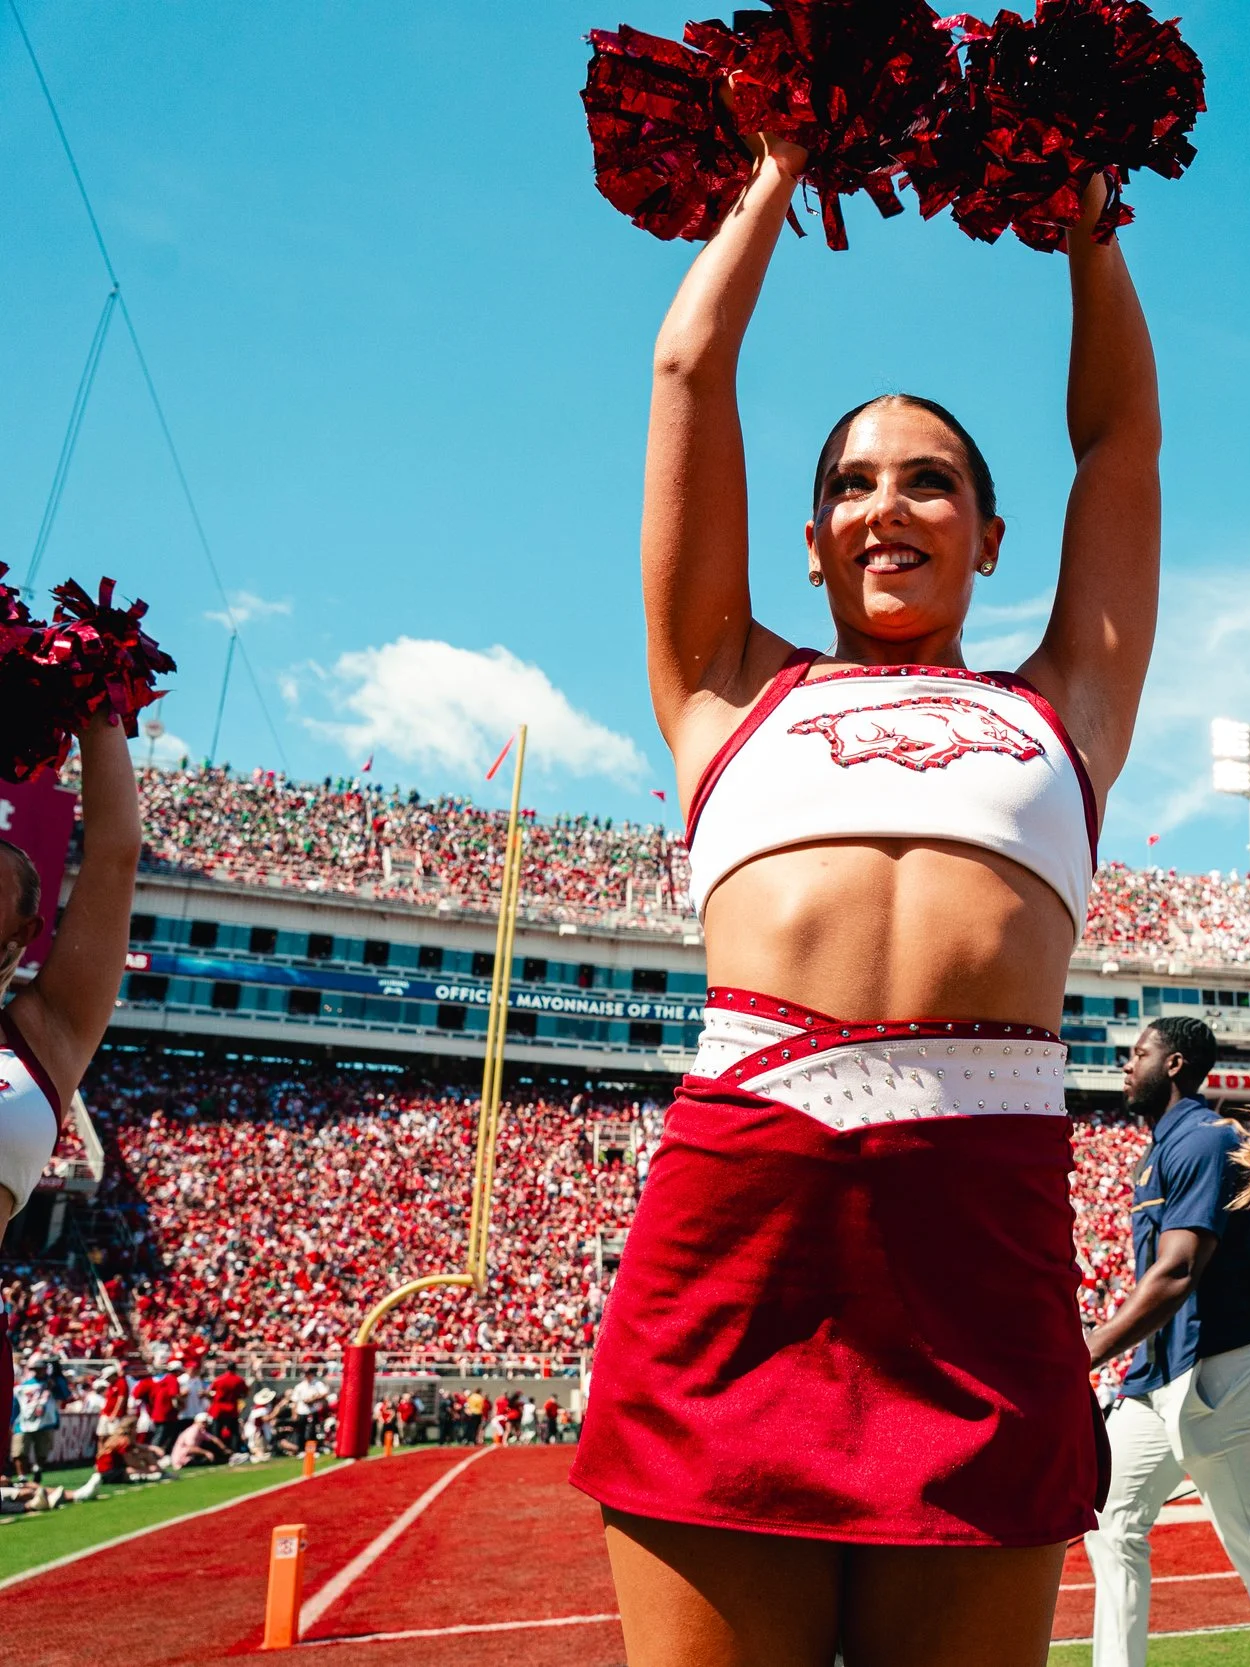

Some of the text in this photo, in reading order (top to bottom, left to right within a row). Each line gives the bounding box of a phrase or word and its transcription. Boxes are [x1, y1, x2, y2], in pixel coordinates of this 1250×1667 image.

[436, 984, 514, 1006] OFFICI
[516, 993, 624, 1016] MAYONNAISE
[628, 1004, 650, 1018] OF
[654, 1005, 684, 1020] THE
